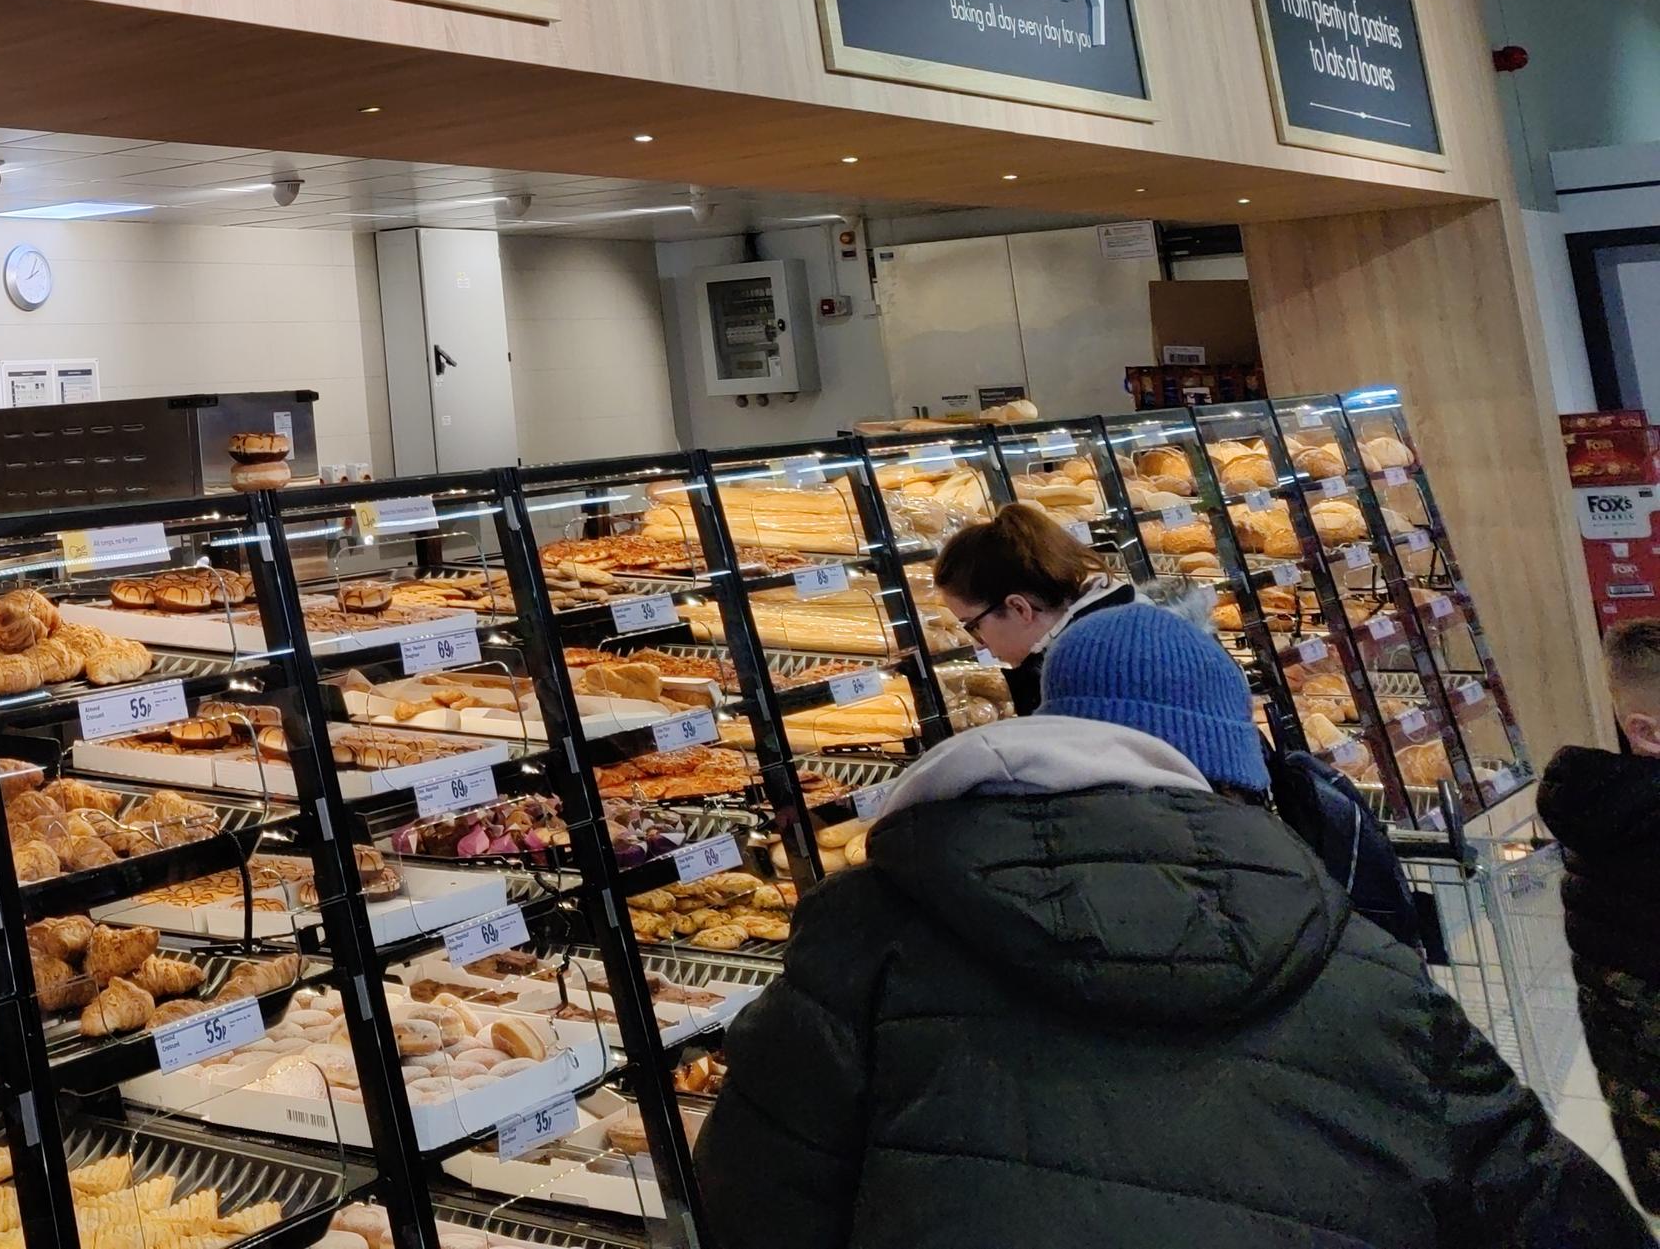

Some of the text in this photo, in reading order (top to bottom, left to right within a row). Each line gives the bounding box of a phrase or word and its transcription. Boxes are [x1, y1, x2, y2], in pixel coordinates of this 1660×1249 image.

[986, 2, 997, 27] all
[998, 6, 1016, 38] day
[1018, 18, 1042, 44] every
[1044, 16, 1061, 48] day
[1061, 19, 1074, 44] for
[1074, 32, 1092, 52] you
[1349, 0, 1361, 35] of
[1362, 16, 1402, 49] pastries
[1309, 37, 1395, 91] to lots of loaves
[130, 697, 151, 719] 55p
[205, 1018, 226, 1043] 55p
